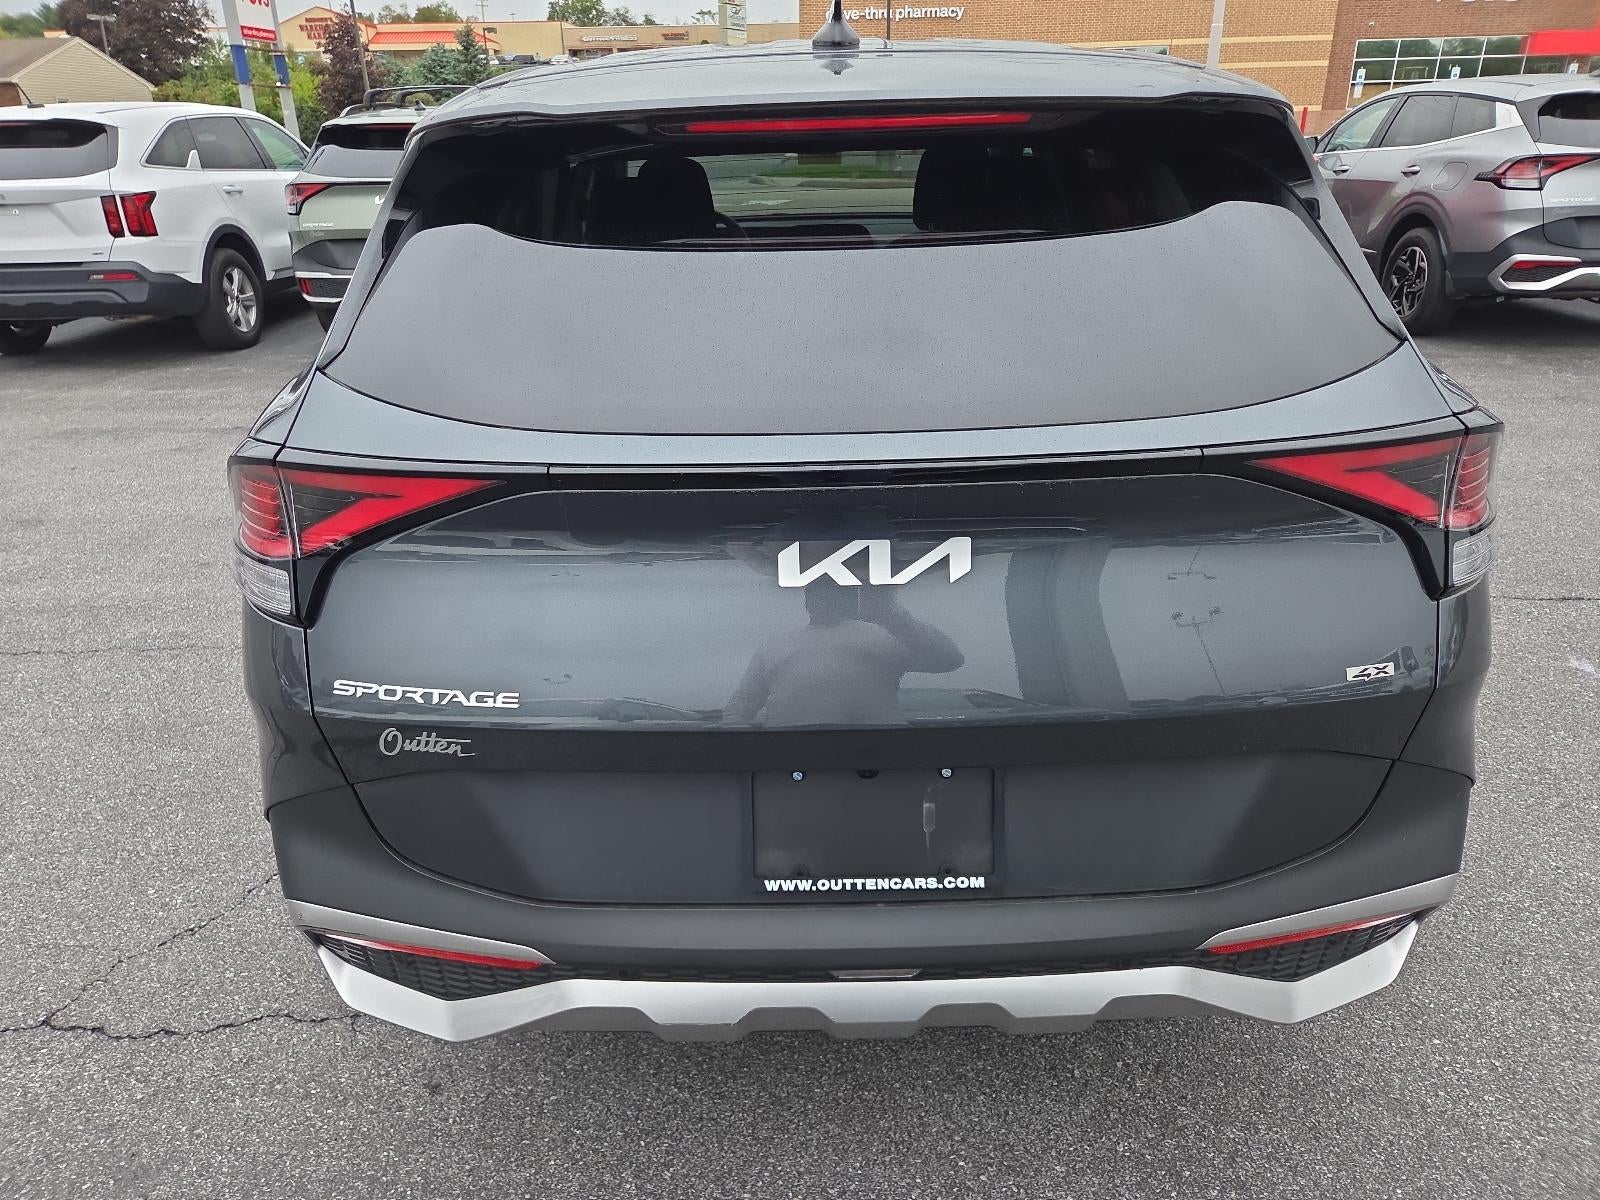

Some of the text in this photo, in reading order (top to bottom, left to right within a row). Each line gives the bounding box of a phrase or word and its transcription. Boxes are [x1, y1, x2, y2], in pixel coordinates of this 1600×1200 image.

[826, 5, 965, 21] ve-thru pharmacy
[777, 536, 972, 587] KIA
[333, 679, 520, 708] SPORTAGE
[378, 727, 476, 757] Outten
[764, 877, 985, 892] WWW.OUTTENCARS.COM
